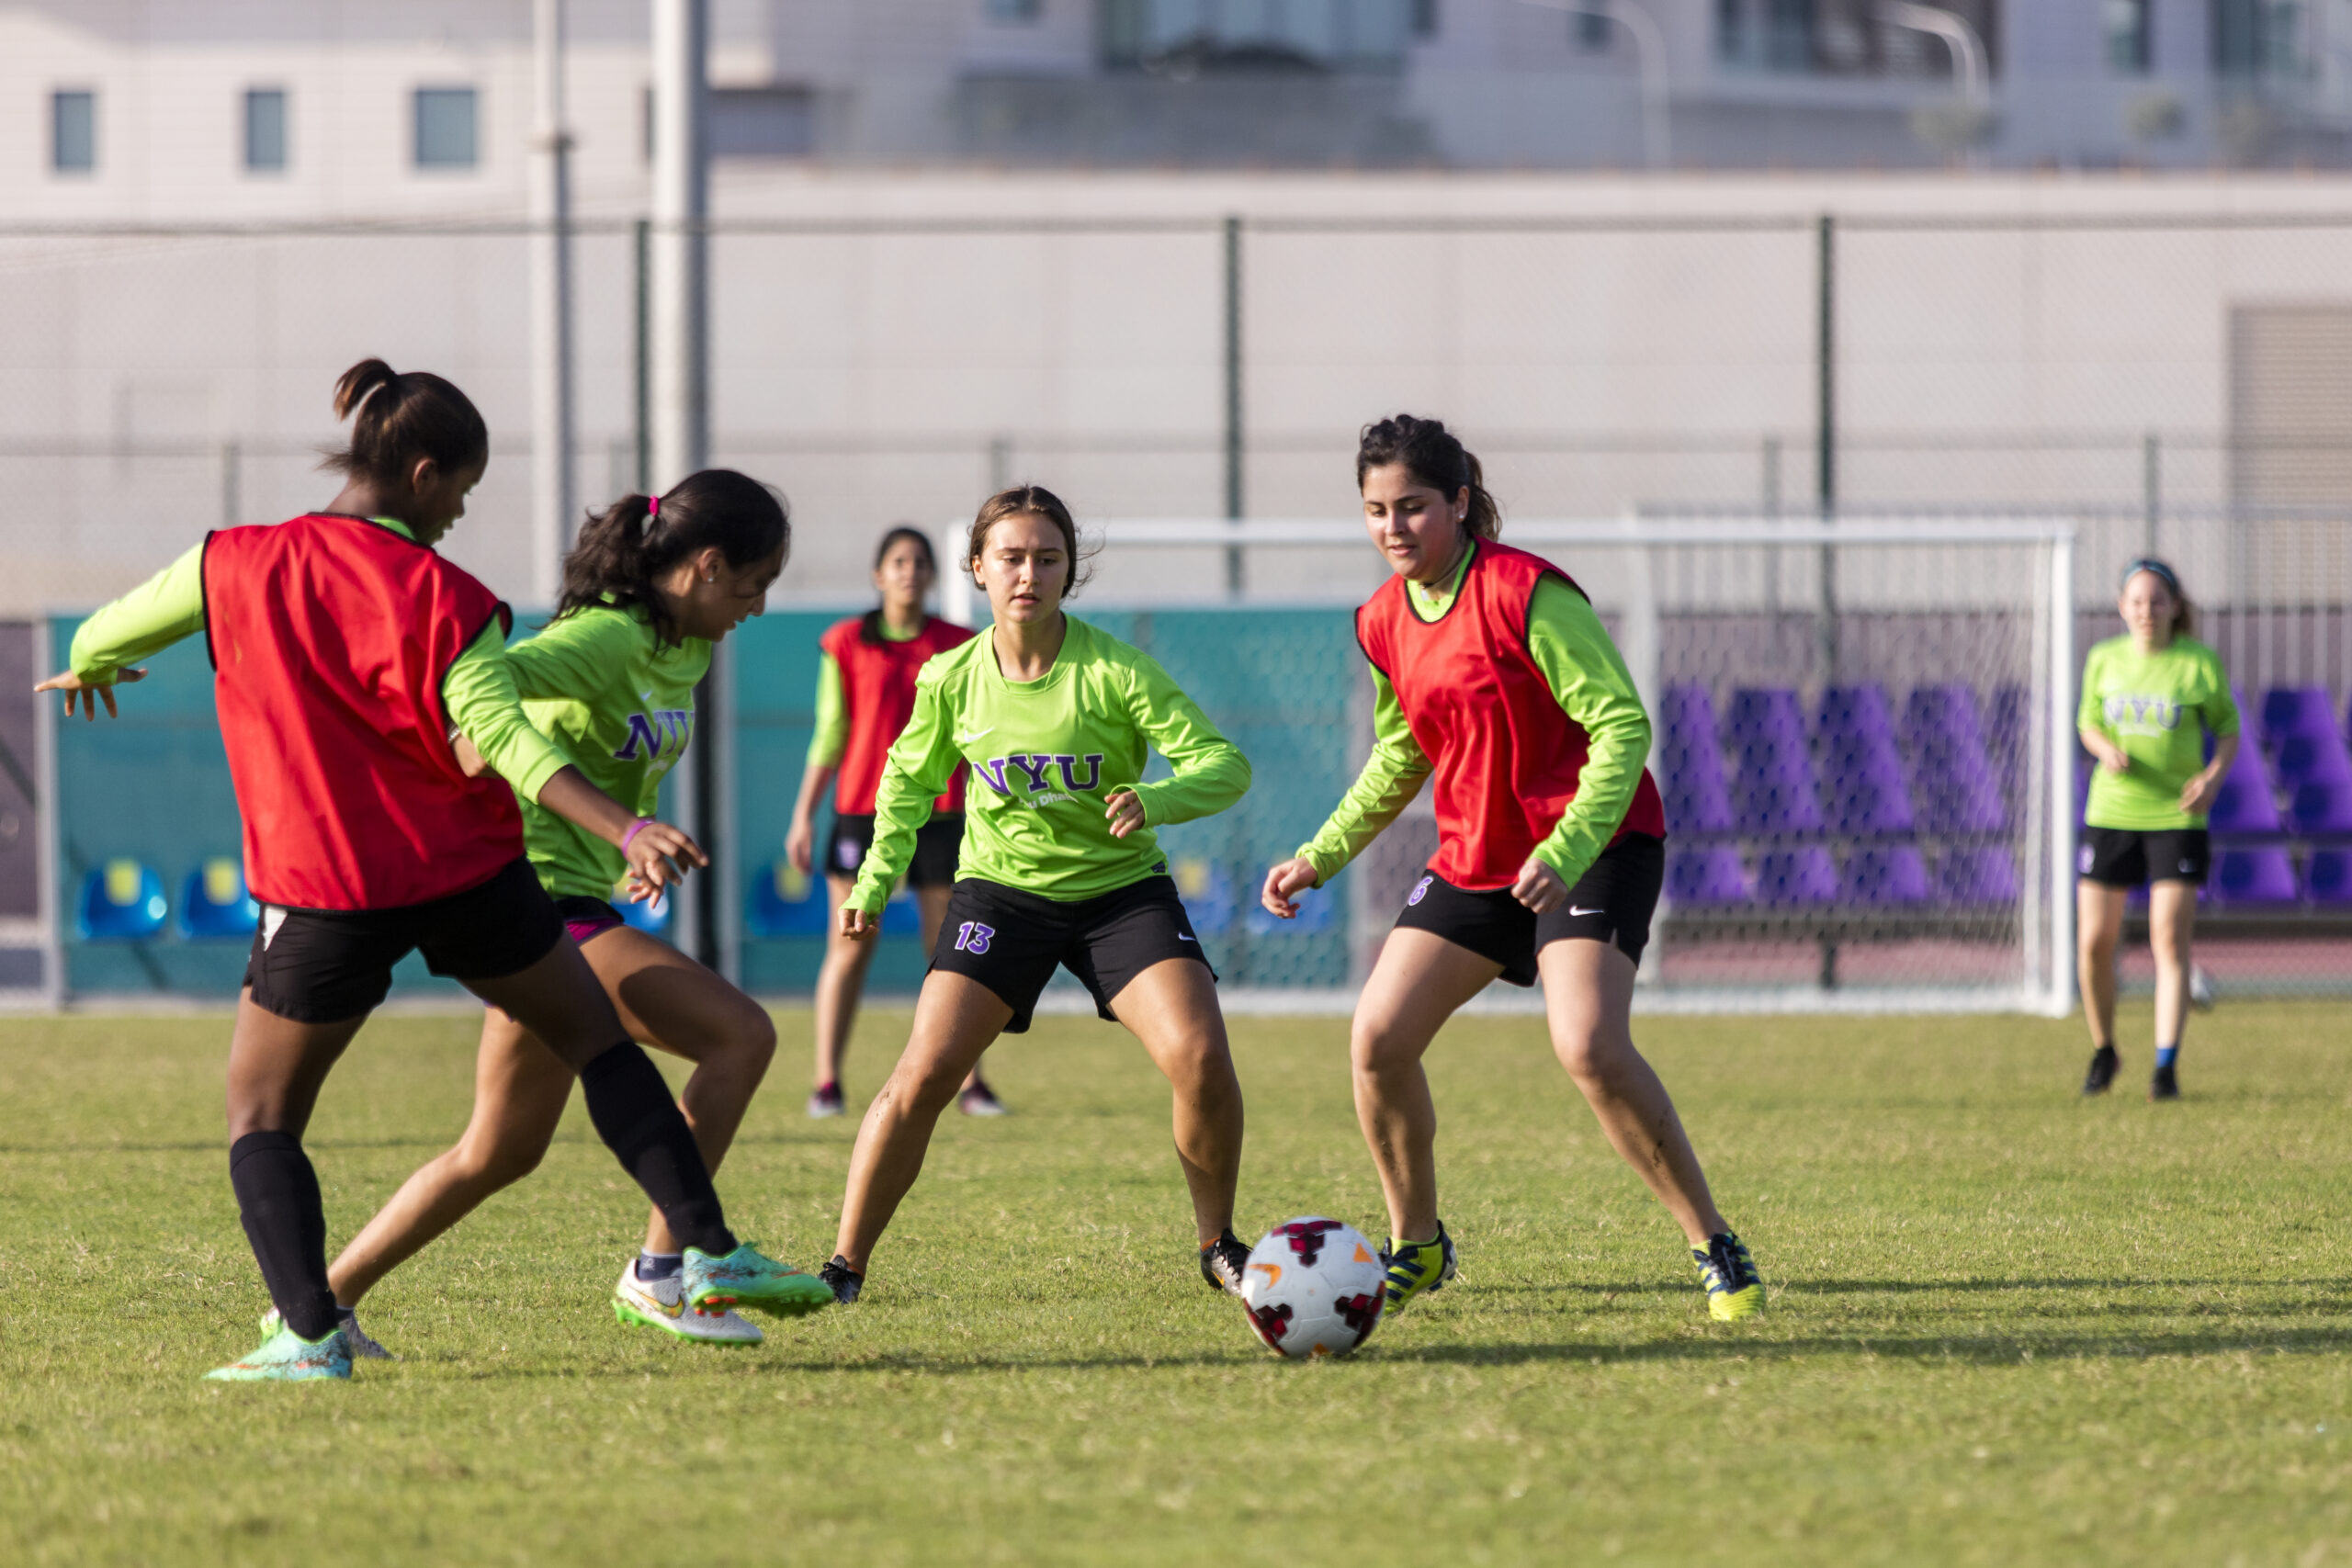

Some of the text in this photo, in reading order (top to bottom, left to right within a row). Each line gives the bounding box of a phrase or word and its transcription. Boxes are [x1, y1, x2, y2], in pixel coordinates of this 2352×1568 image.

[2103, 695, 2182, 730] NYU
[972, 754, 1103, 795] NYU
[955, 921, 995, 954] 13
